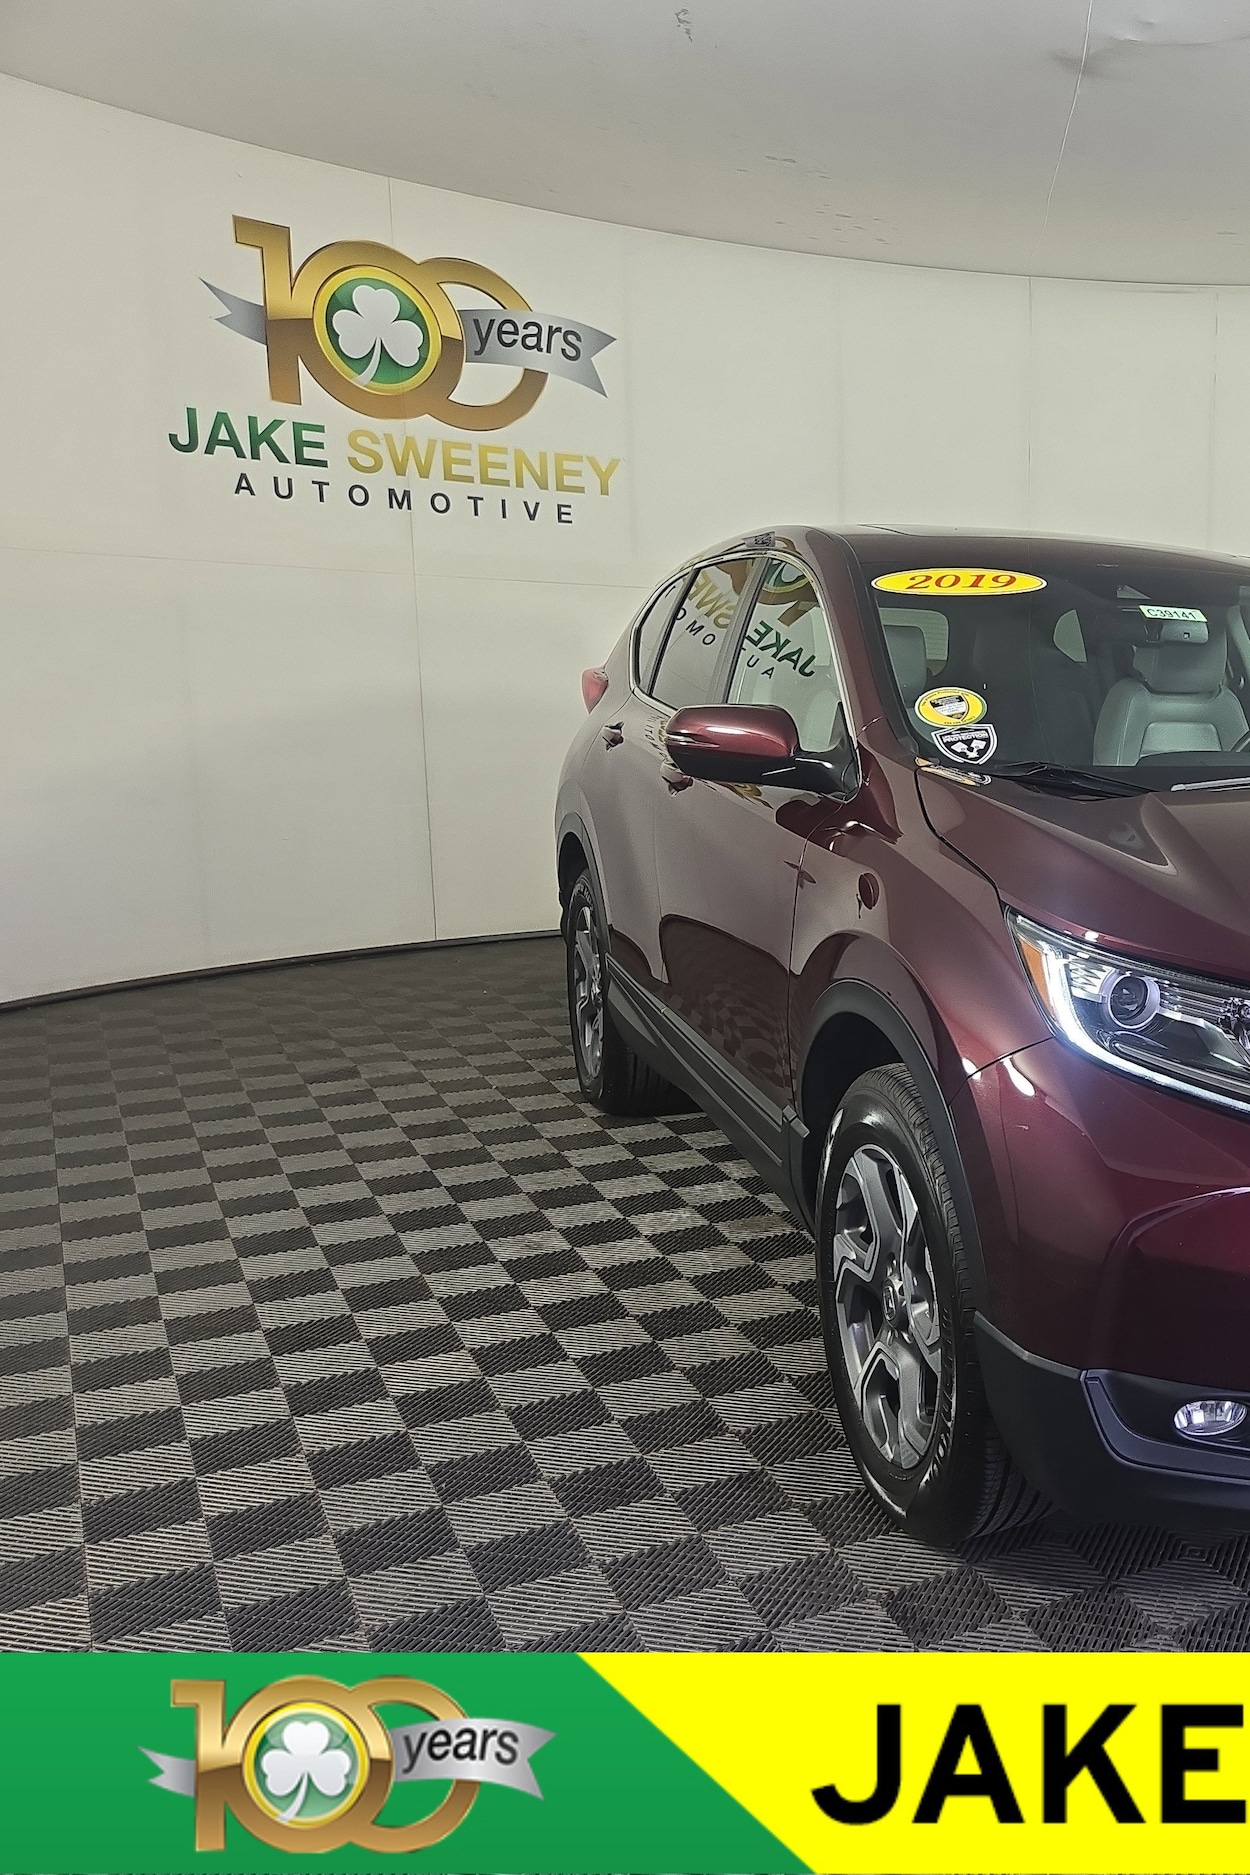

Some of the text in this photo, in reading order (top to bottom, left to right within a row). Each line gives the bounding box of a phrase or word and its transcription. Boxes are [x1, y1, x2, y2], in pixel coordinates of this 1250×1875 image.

[232, 214, 583, 431] 100 years
[167, 406, 621, 496] JAKE SWEENEY
[234, 472, 574, 524] AUTOMOTIVE
[905, 574, 1017, 590] 2019
[1146, 608, 1197, 620] C39141
